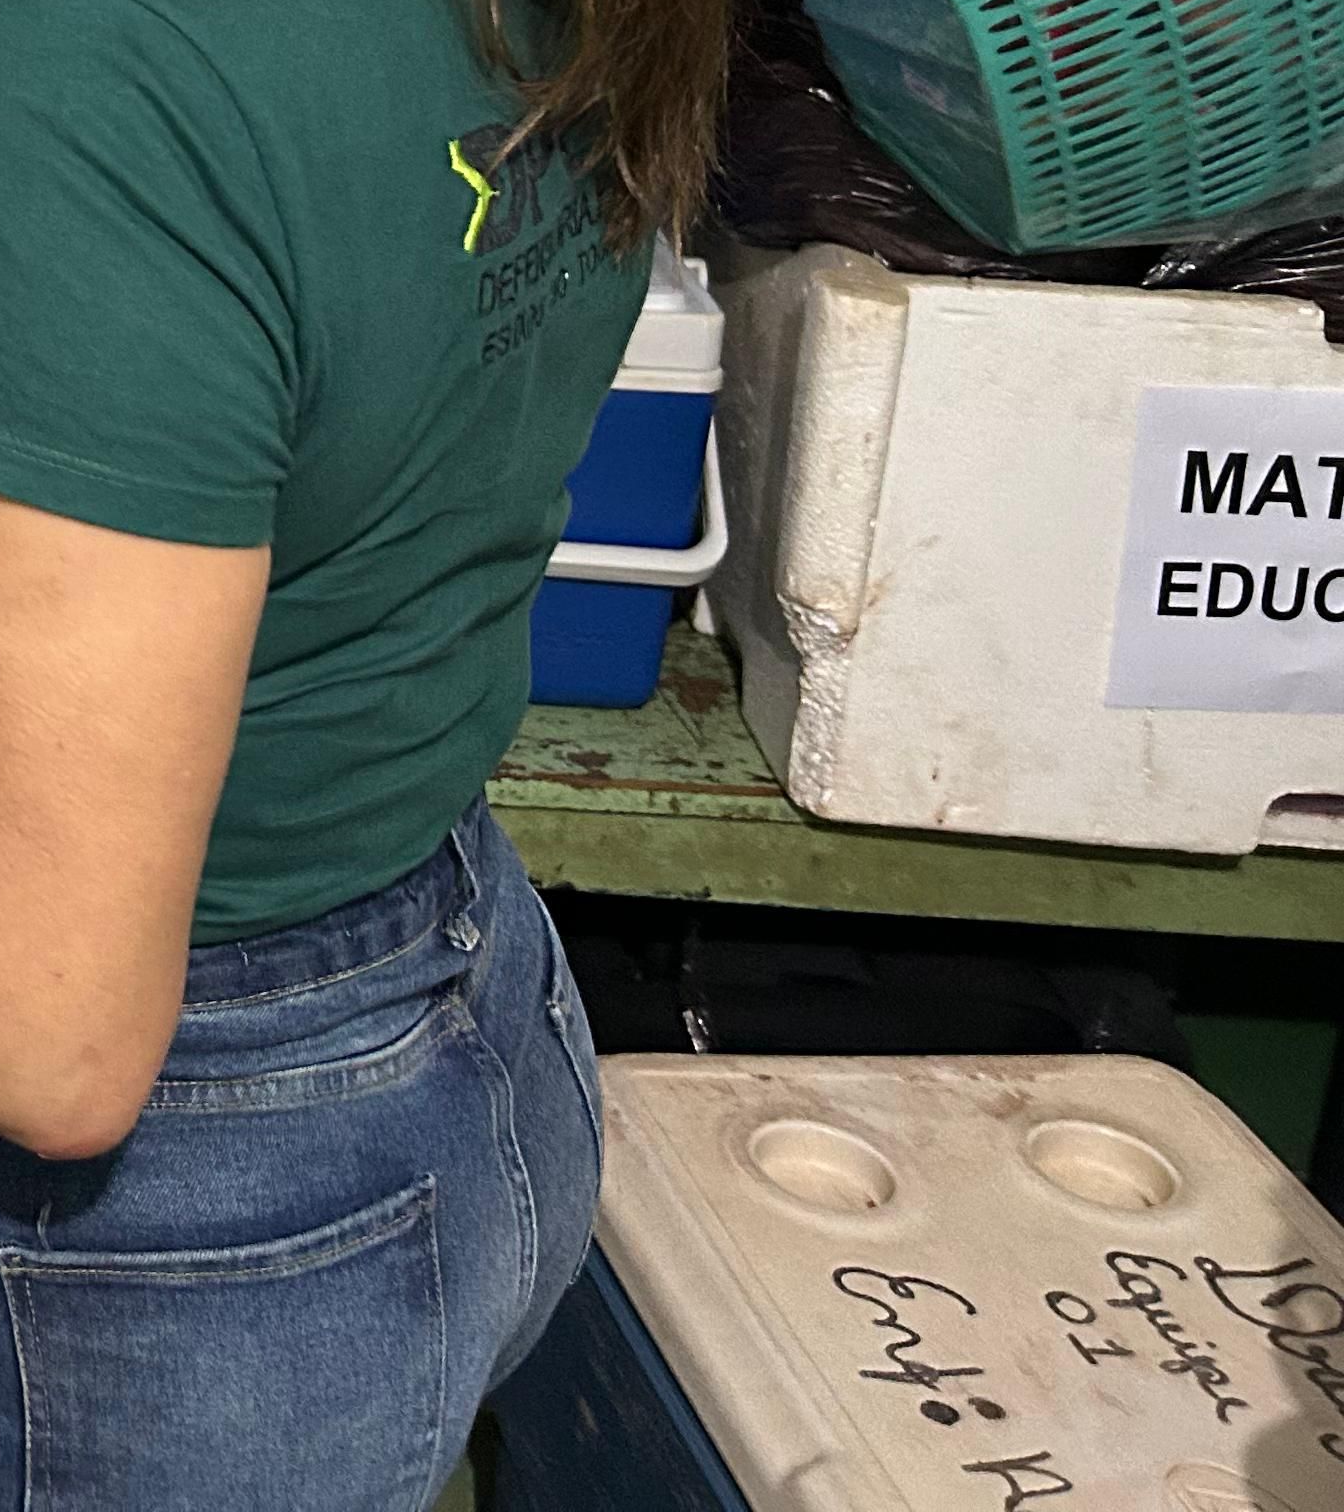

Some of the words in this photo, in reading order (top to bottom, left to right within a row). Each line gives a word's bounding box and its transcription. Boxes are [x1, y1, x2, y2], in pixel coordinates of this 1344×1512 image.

[1157, 562, 1344, 624] EDUC
[1045, 1290, 1135, 1366] 01
[1105, 1250, 1250, 1425] Equipe
